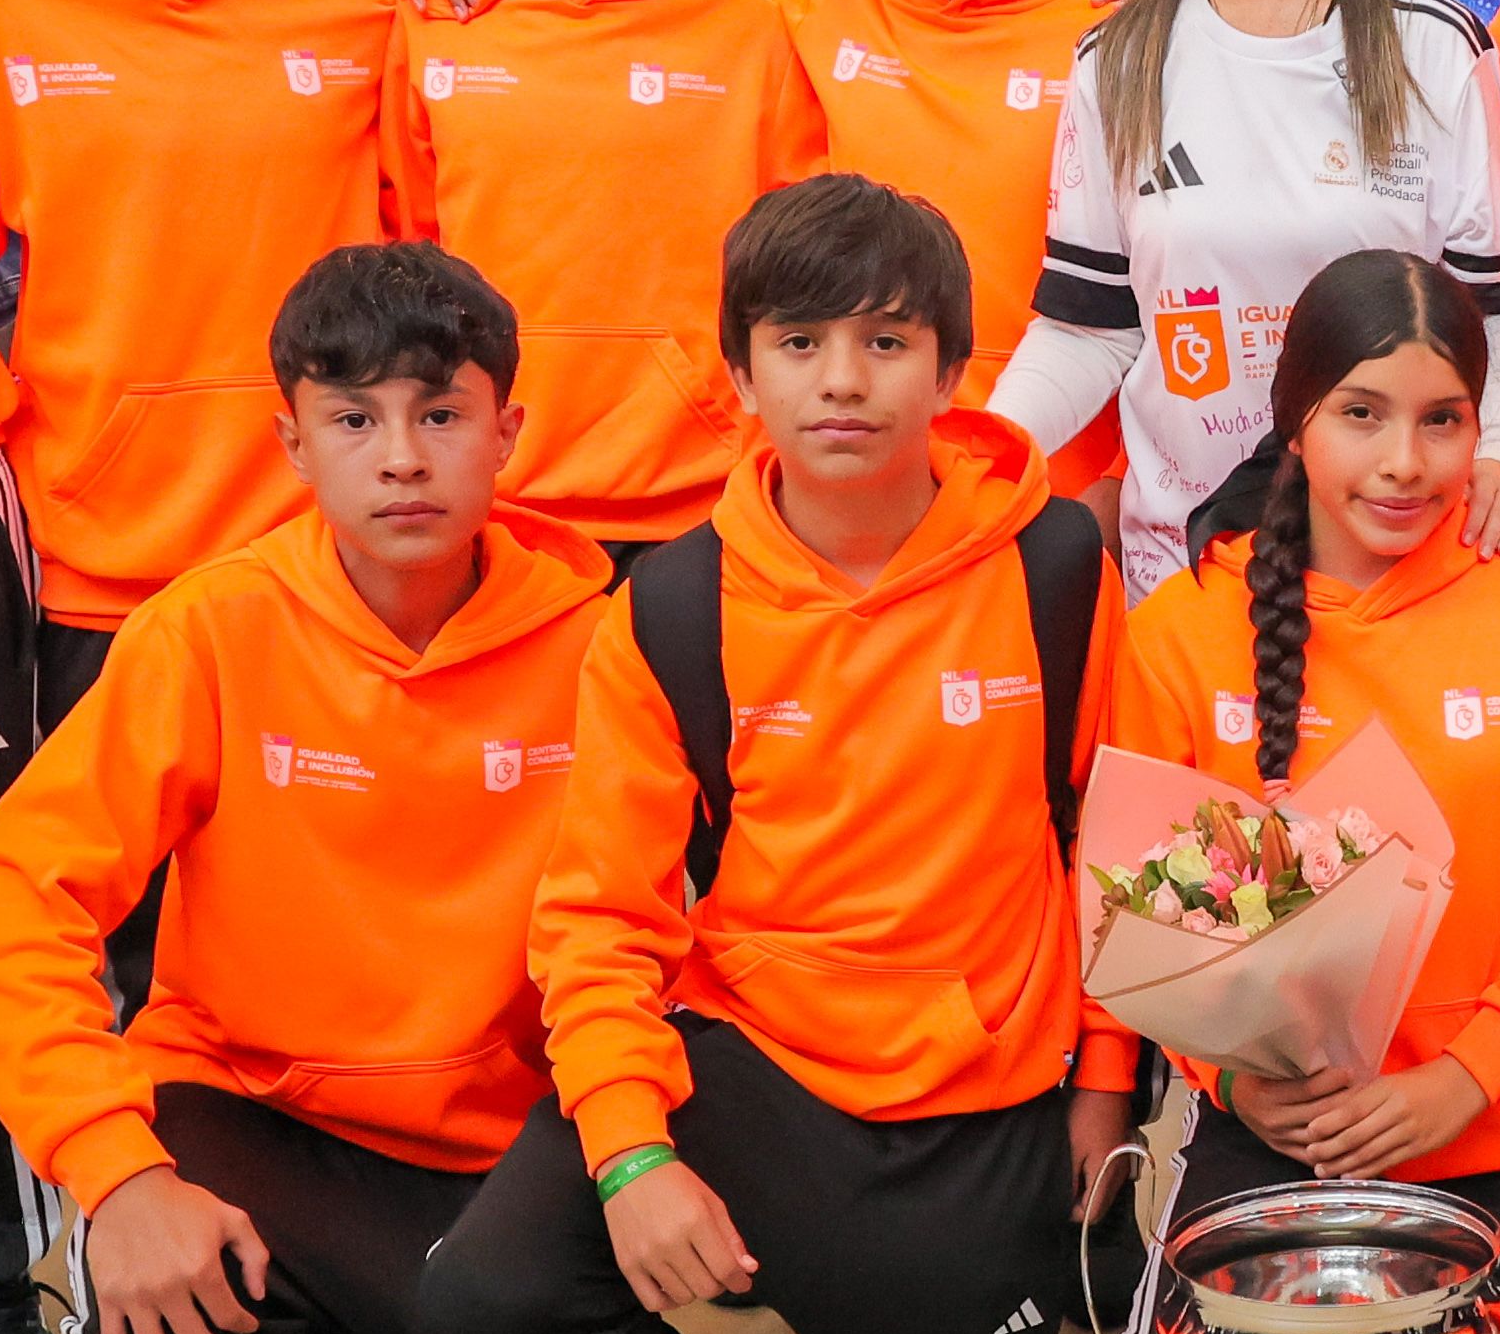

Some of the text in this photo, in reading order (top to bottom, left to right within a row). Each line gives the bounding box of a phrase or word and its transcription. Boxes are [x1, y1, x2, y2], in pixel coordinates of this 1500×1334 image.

[1371, 168, 1424, 186] Program
[1371, 183, 1425, 203] Apodaca
[1237, 304, 1292, 324] IGUA
[298, 748, 360, 765] IGUALDAD
